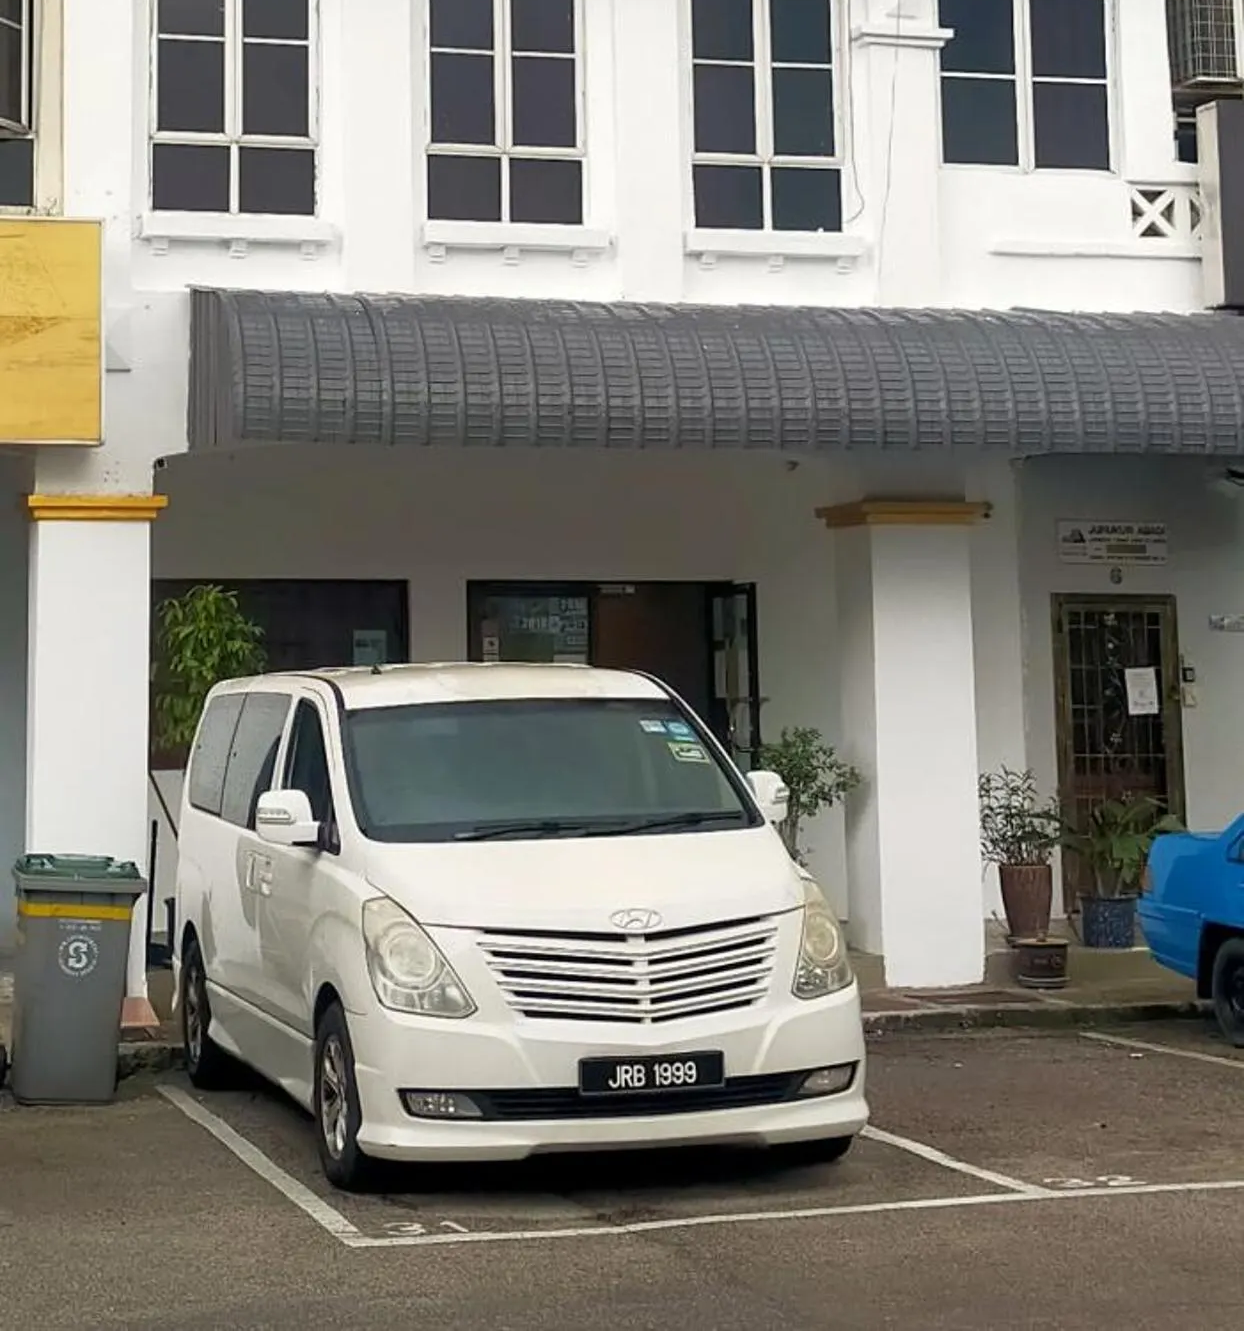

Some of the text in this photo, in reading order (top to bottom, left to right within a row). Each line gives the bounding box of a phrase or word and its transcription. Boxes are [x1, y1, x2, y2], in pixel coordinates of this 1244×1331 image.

[1110, 567, 1122, 584] 6
[608, 1061, 697, 1089] JRB 1999
[383, 1221, 469, 1235] 31
